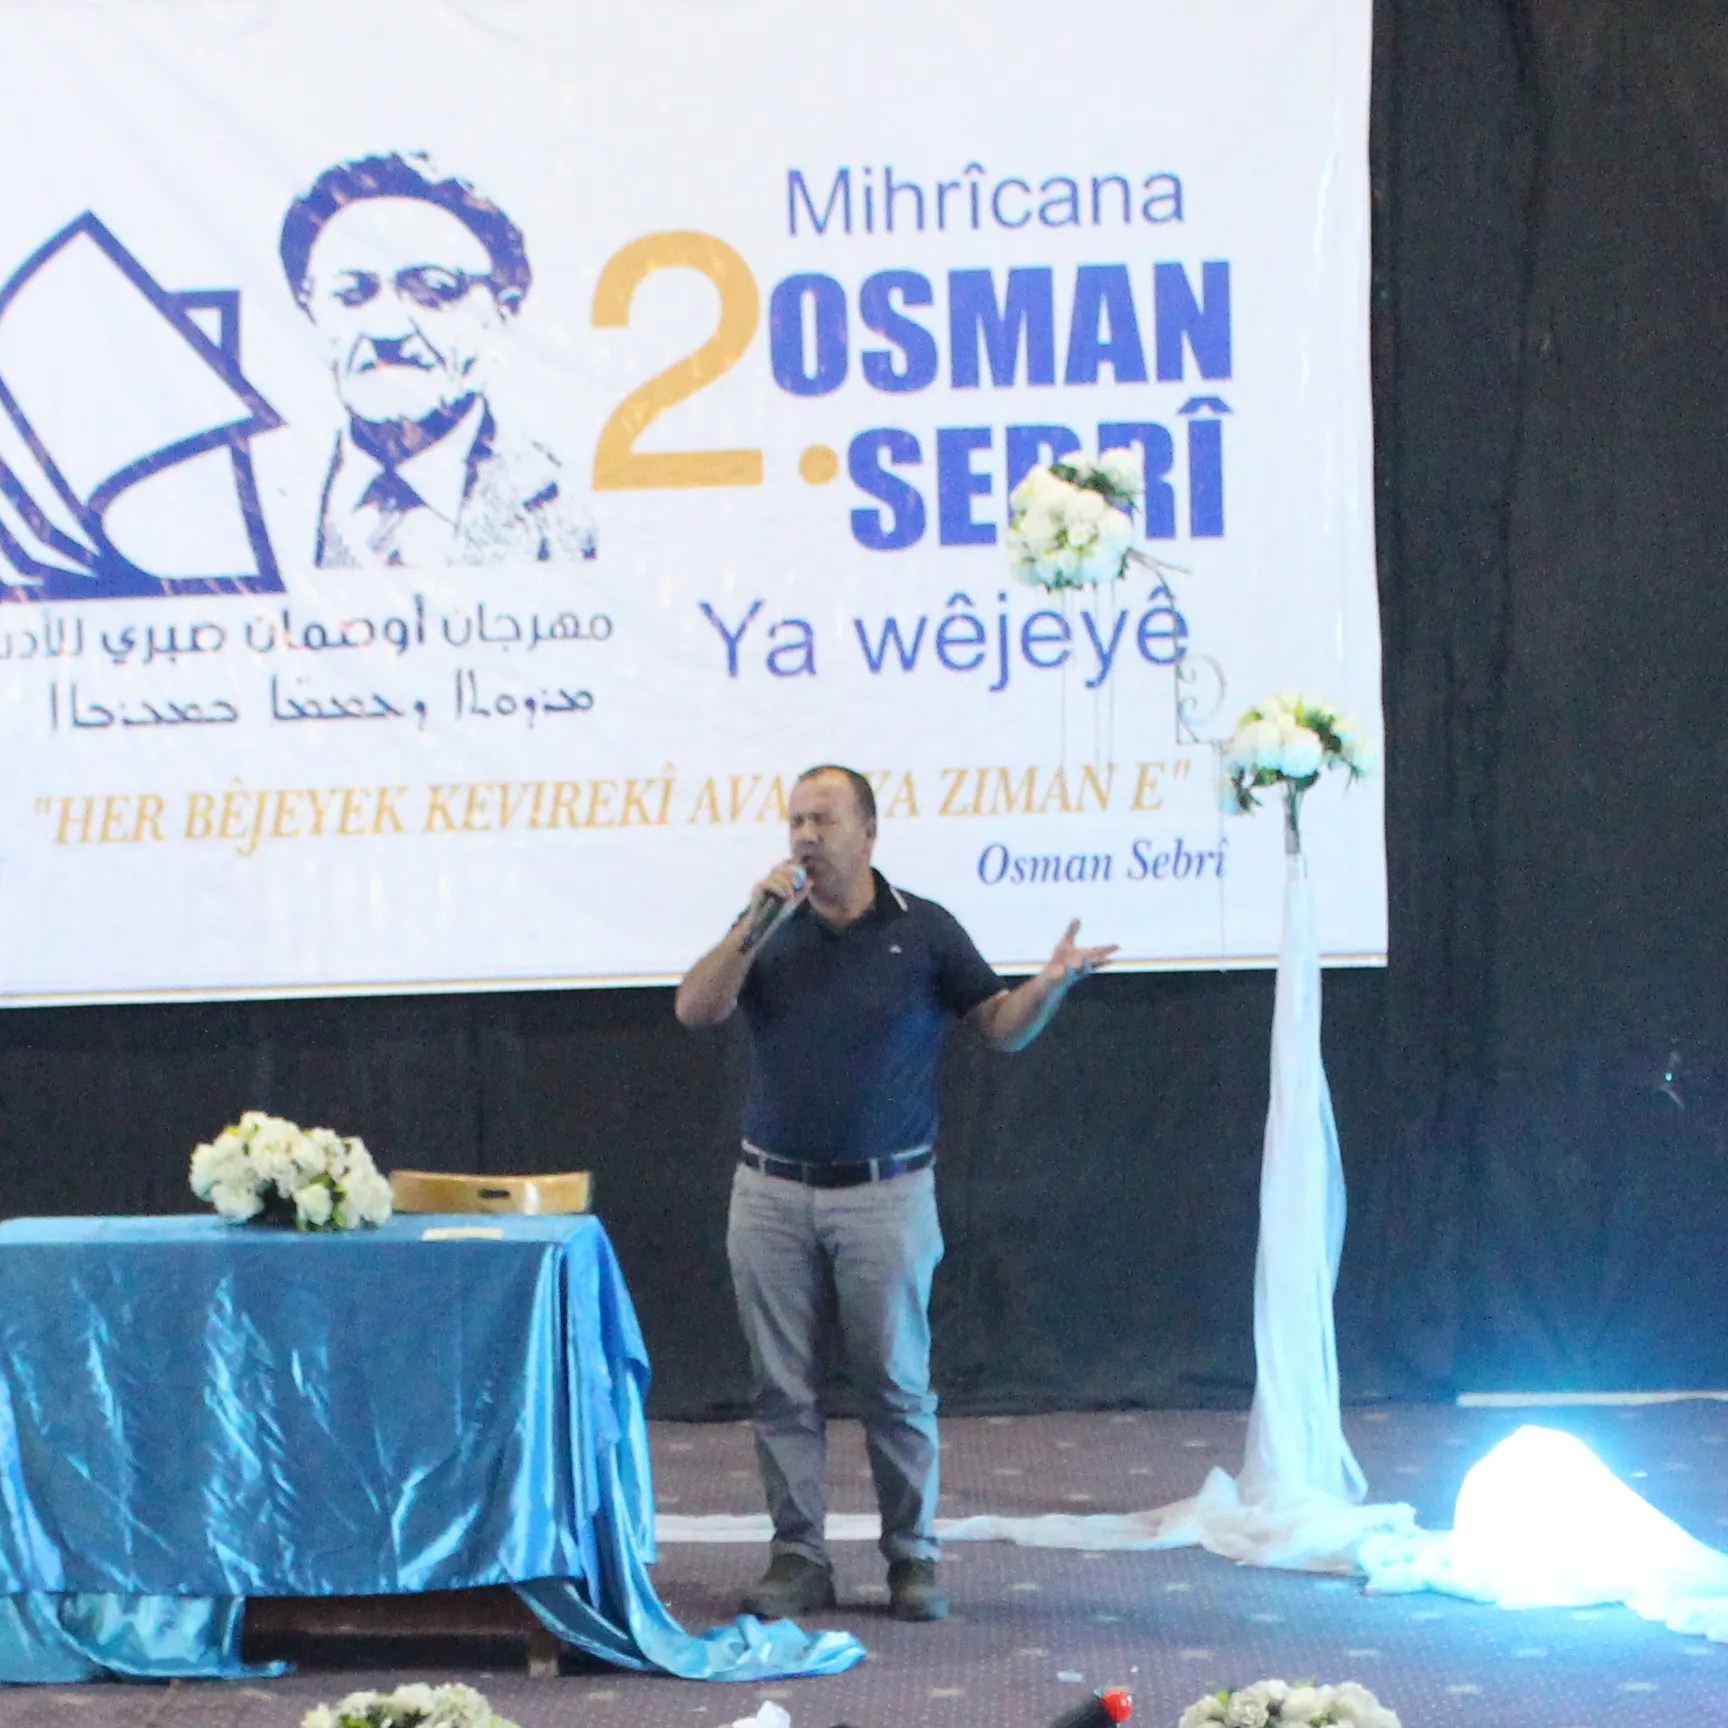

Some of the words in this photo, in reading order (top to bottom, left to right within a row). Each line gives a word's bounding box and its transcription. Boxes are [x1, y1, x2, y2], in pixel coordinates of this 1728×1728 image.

[787, 161, 1185, 236] Mihrîcana
[770, 259, 1233, 398] OSMAN
[102, 623, 226, 664] صبري
[443, 602, 613, 650] مهرجان
[699, 599, 817, 678] Ya
[854, 586, 1189, 692] wêjeyê
[183, 775, 409, 857] BÊJEYEK
[422, 762, 677, 833] KEVIREKÎ
[937, 762, 1116, 817] ZIMAN
[976, 842, 1112, 886] Osman
[1126, 836, 1229, 881] Sebrî
